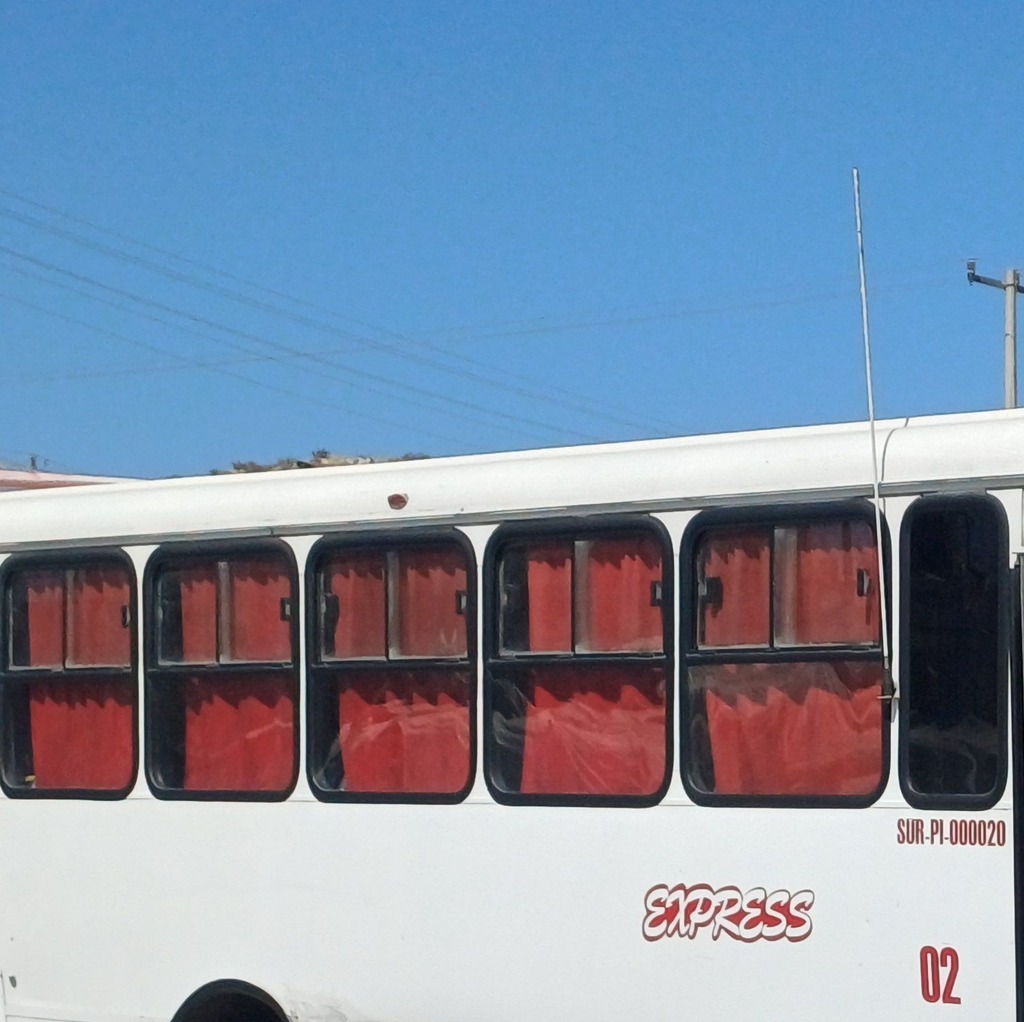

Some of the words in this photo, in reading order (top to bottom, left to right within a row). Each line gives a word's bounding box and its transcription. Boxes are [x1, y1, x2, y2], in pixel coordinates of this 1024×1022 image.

[897, 818, 1006, 847] SUR-PI-000020
[642, 883, 815, 943] EXPRESS
[920, 946, 961, 1005] 02
